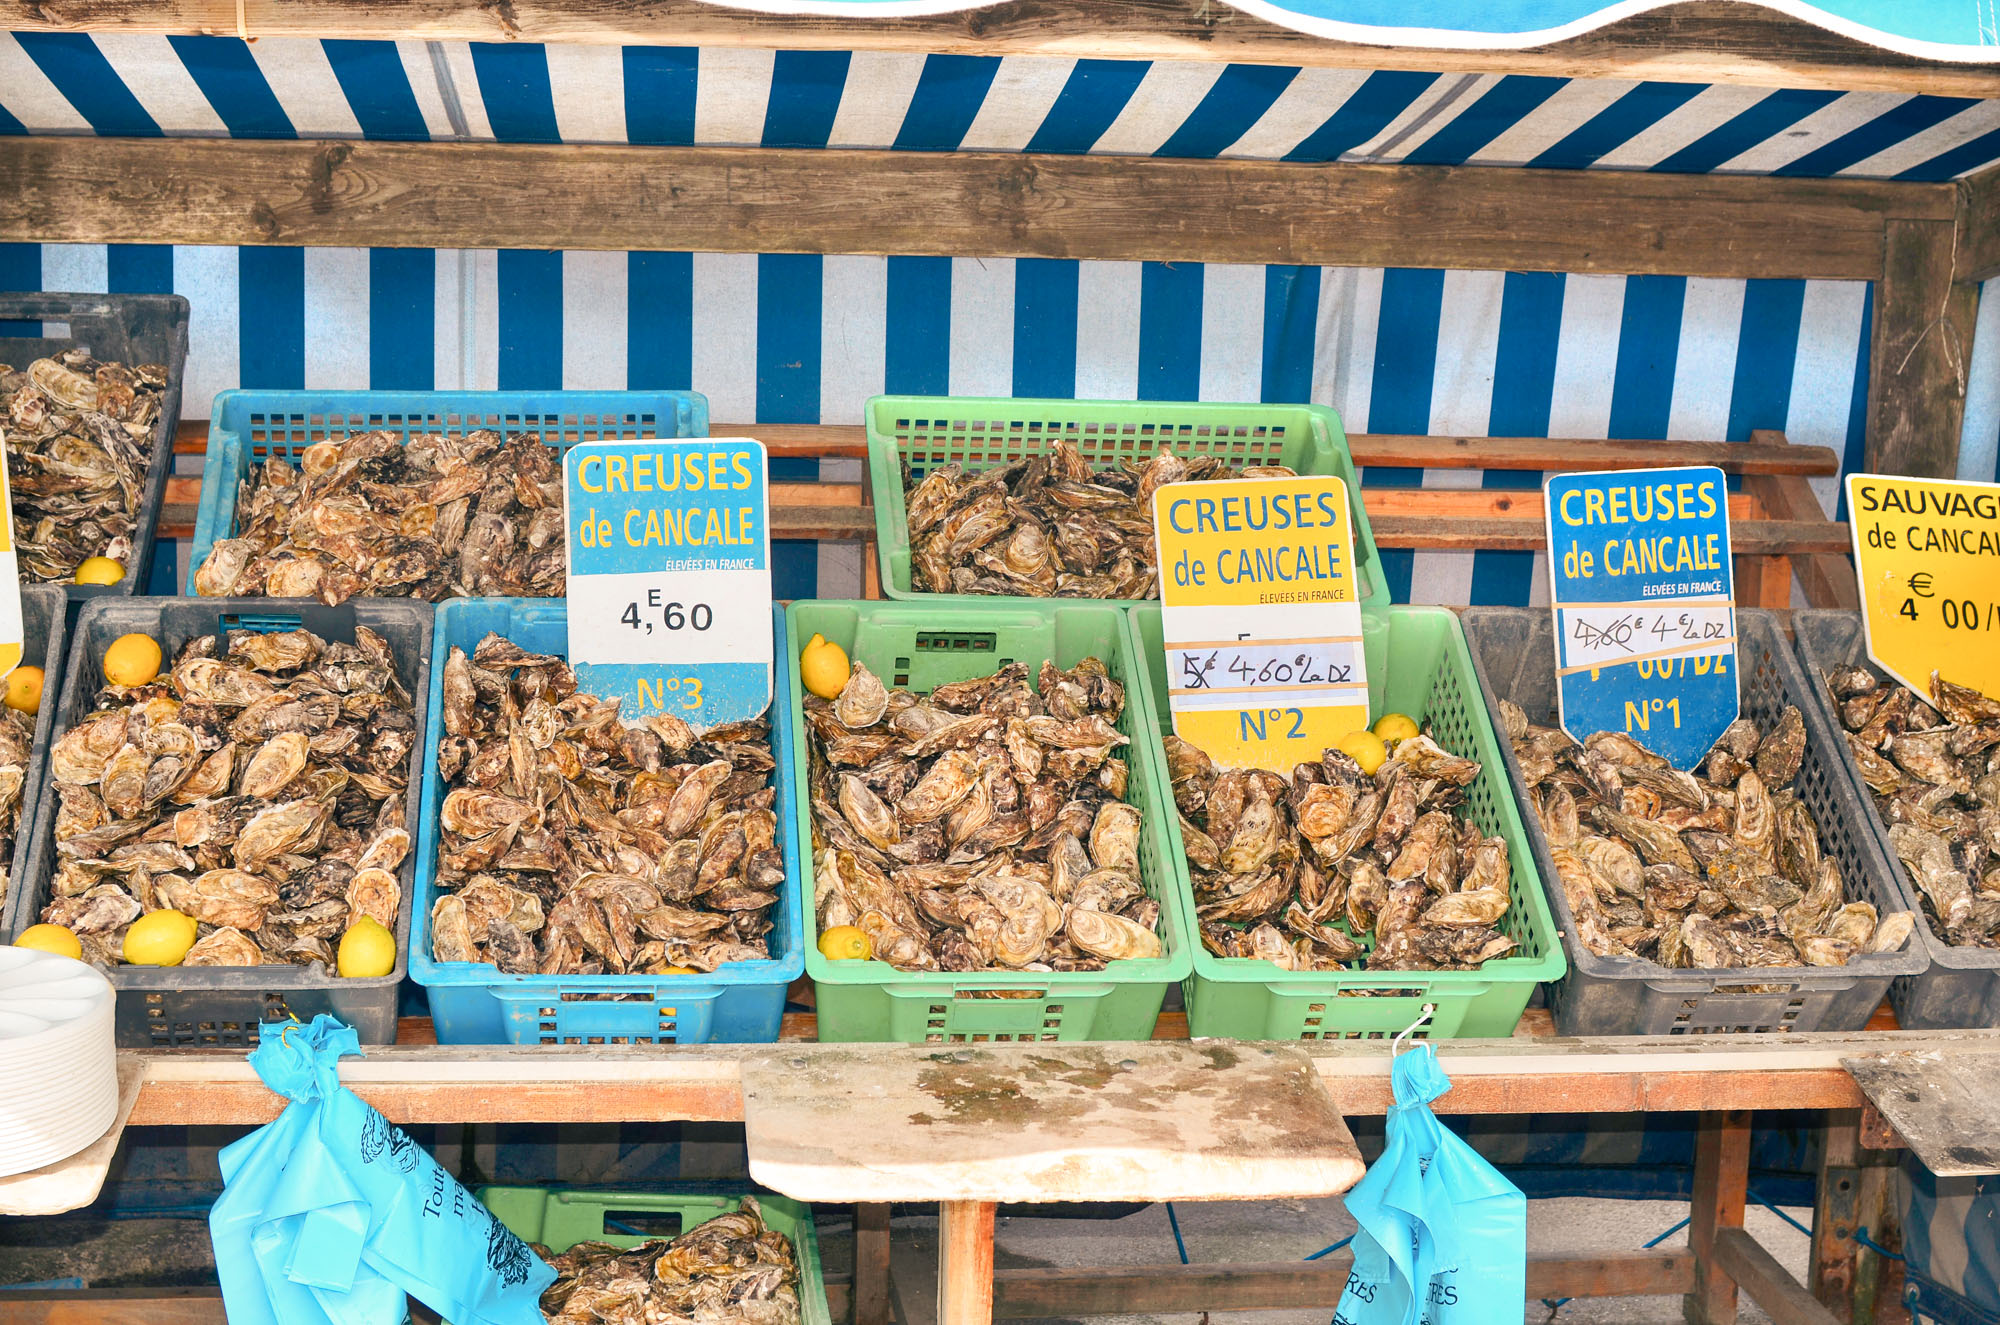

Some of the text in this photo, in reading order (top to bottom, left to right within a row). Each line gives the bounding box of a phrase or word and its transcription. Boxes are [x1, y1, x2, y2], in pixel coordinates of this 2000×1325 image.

[578, 452, 752, 494] CREUSES
[1169, 492, 1337, 535] CREUSES
[1560, 481, 1717, 526] CREUSES
[1861, 486, 2000, 520] SAUVAG
[580, 507, 754, 548] de CANCALE
[1868, 522, 1896, 549] de
[666, 557, 754, 571] ÉLEVÉES EN FRANCE
[1174, 543, 1343, 586] de CANCALE
[1563, 533, 1721, 579] de CANCALE
[1298, 591, 1309, 602] EN
[1311, 589, 1344, 601] FRANCE
[1677, 583, 1689, 594] EN
[1690, 580, 1722, 593] FRANCE
[1704, 622, 1726, 639] DZ
[1942, 598, 2000, 631] 00/
[1328, 664, 1351, 683] DZ
[637, 677, 703, 710] N°3
[1240, 707, 1306, 741] N°2
[1625, 698, 1681, 732] N°1
[1426, 1282, 1458, 1306] RES
